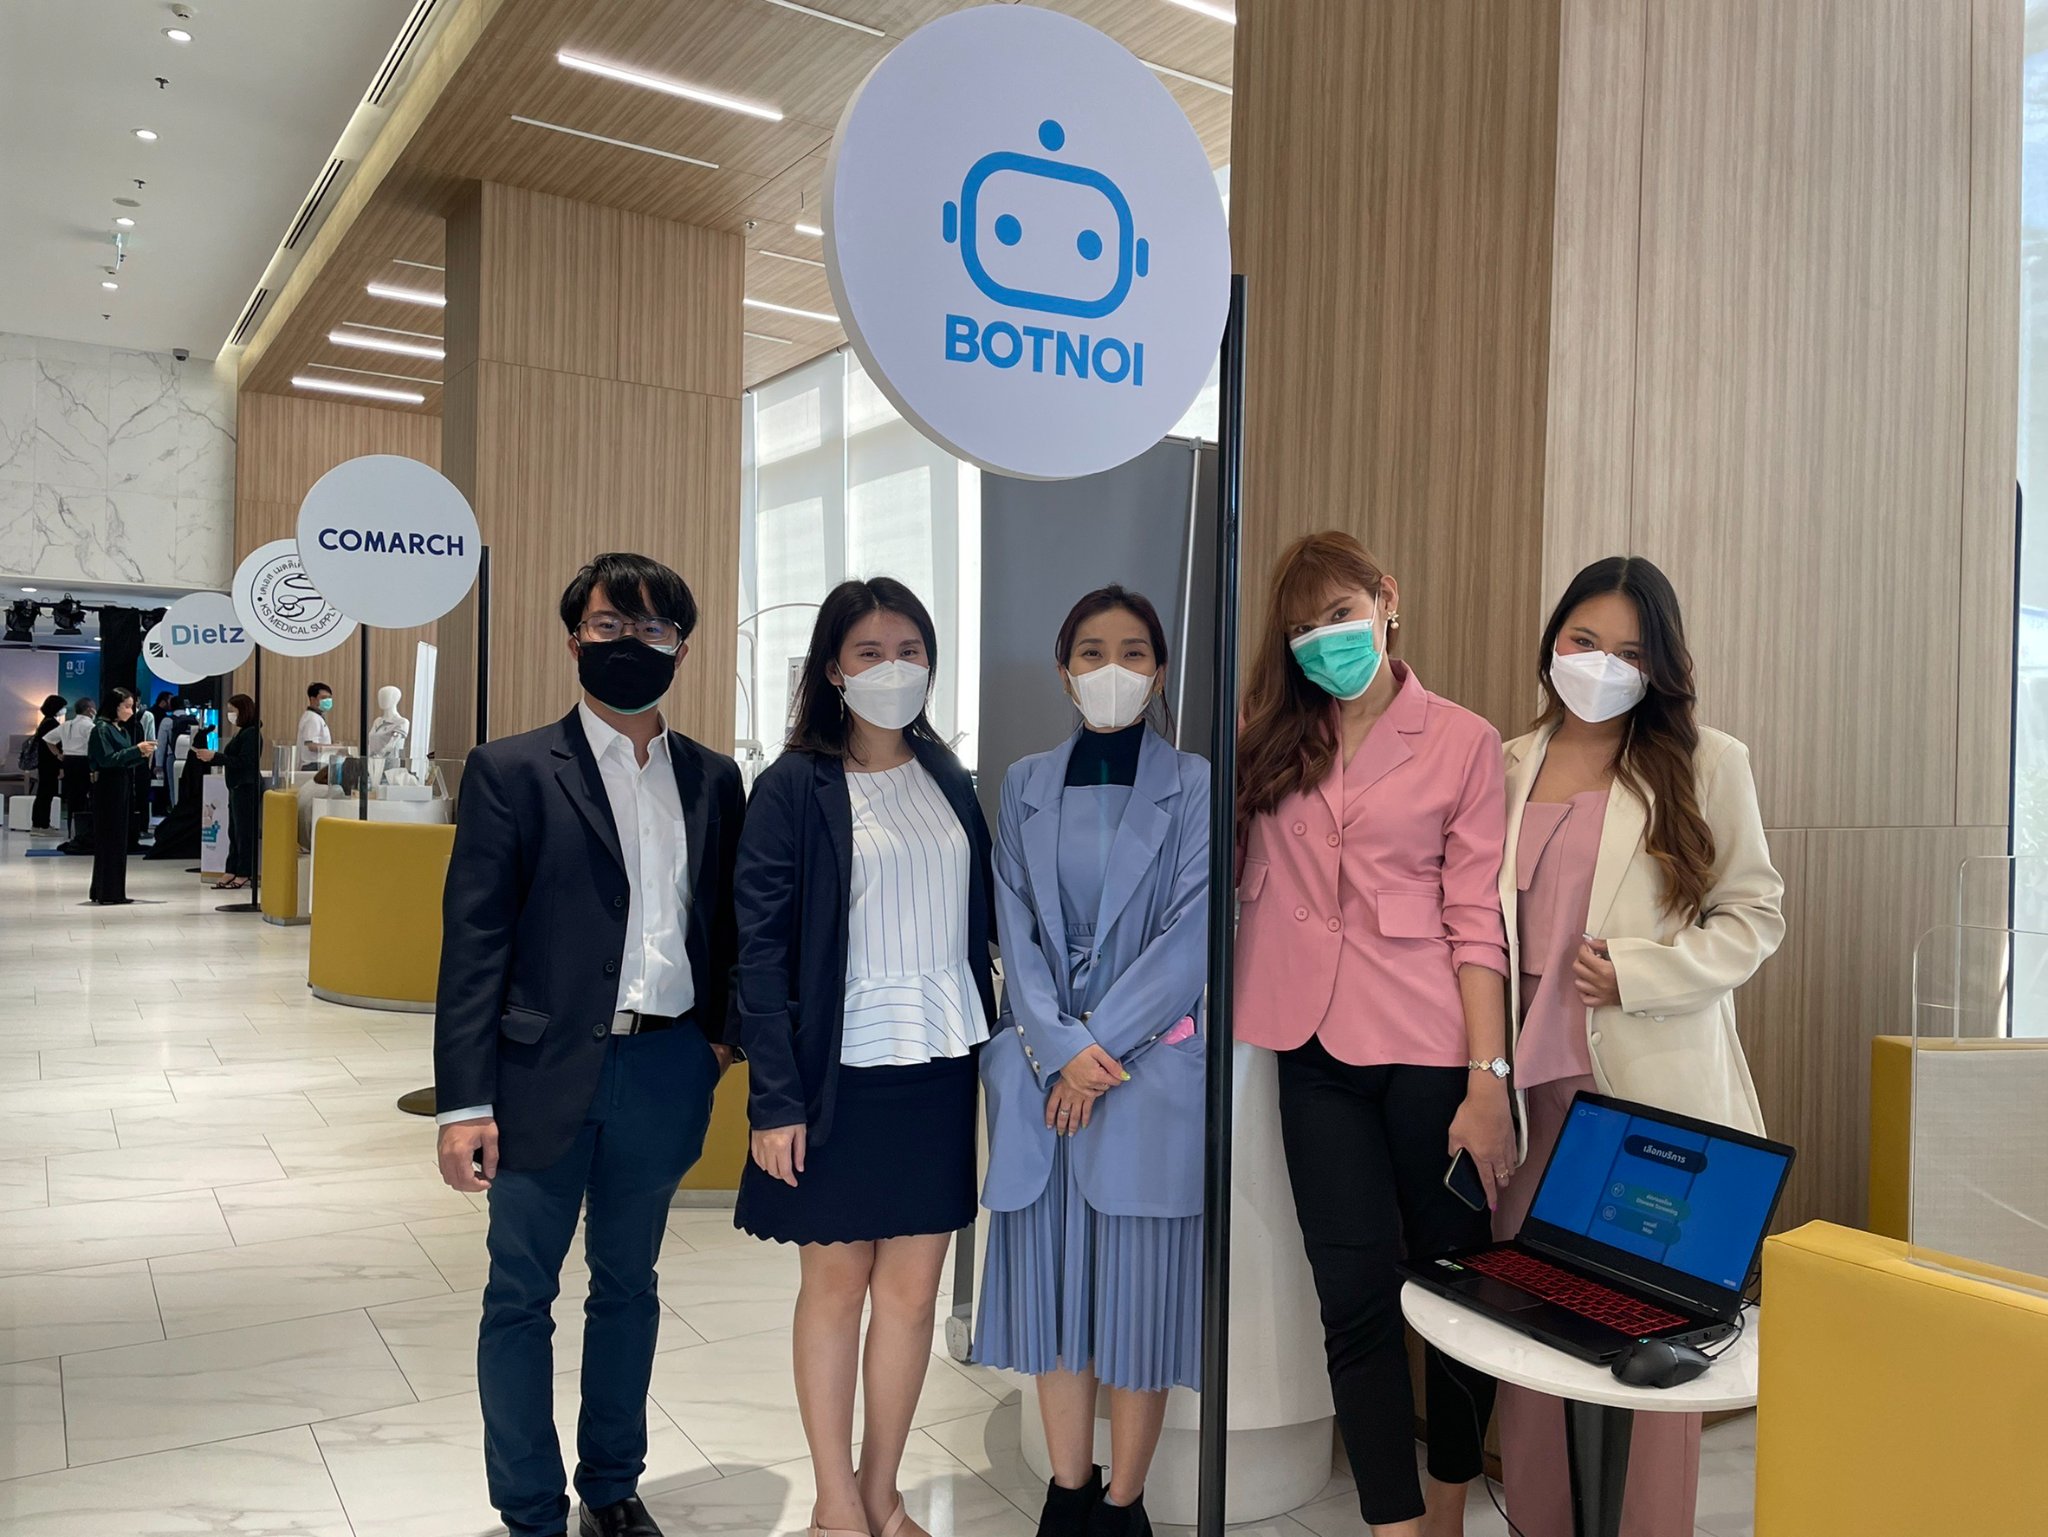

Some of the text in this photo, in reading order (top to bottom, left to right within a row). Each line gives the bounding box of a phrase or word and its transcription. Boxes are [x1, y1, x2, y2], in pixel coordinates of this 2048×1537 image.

[945, 313, 1144, 386] BOTNOI
[318, 528, 464, 556] COMARCH
[260, 603, 337, 635] KS MEDICAL SUPPLY
[171, 623, 245, 646] Dietz
[1643, 1144, 1687, 1164] เลือกบริการ
